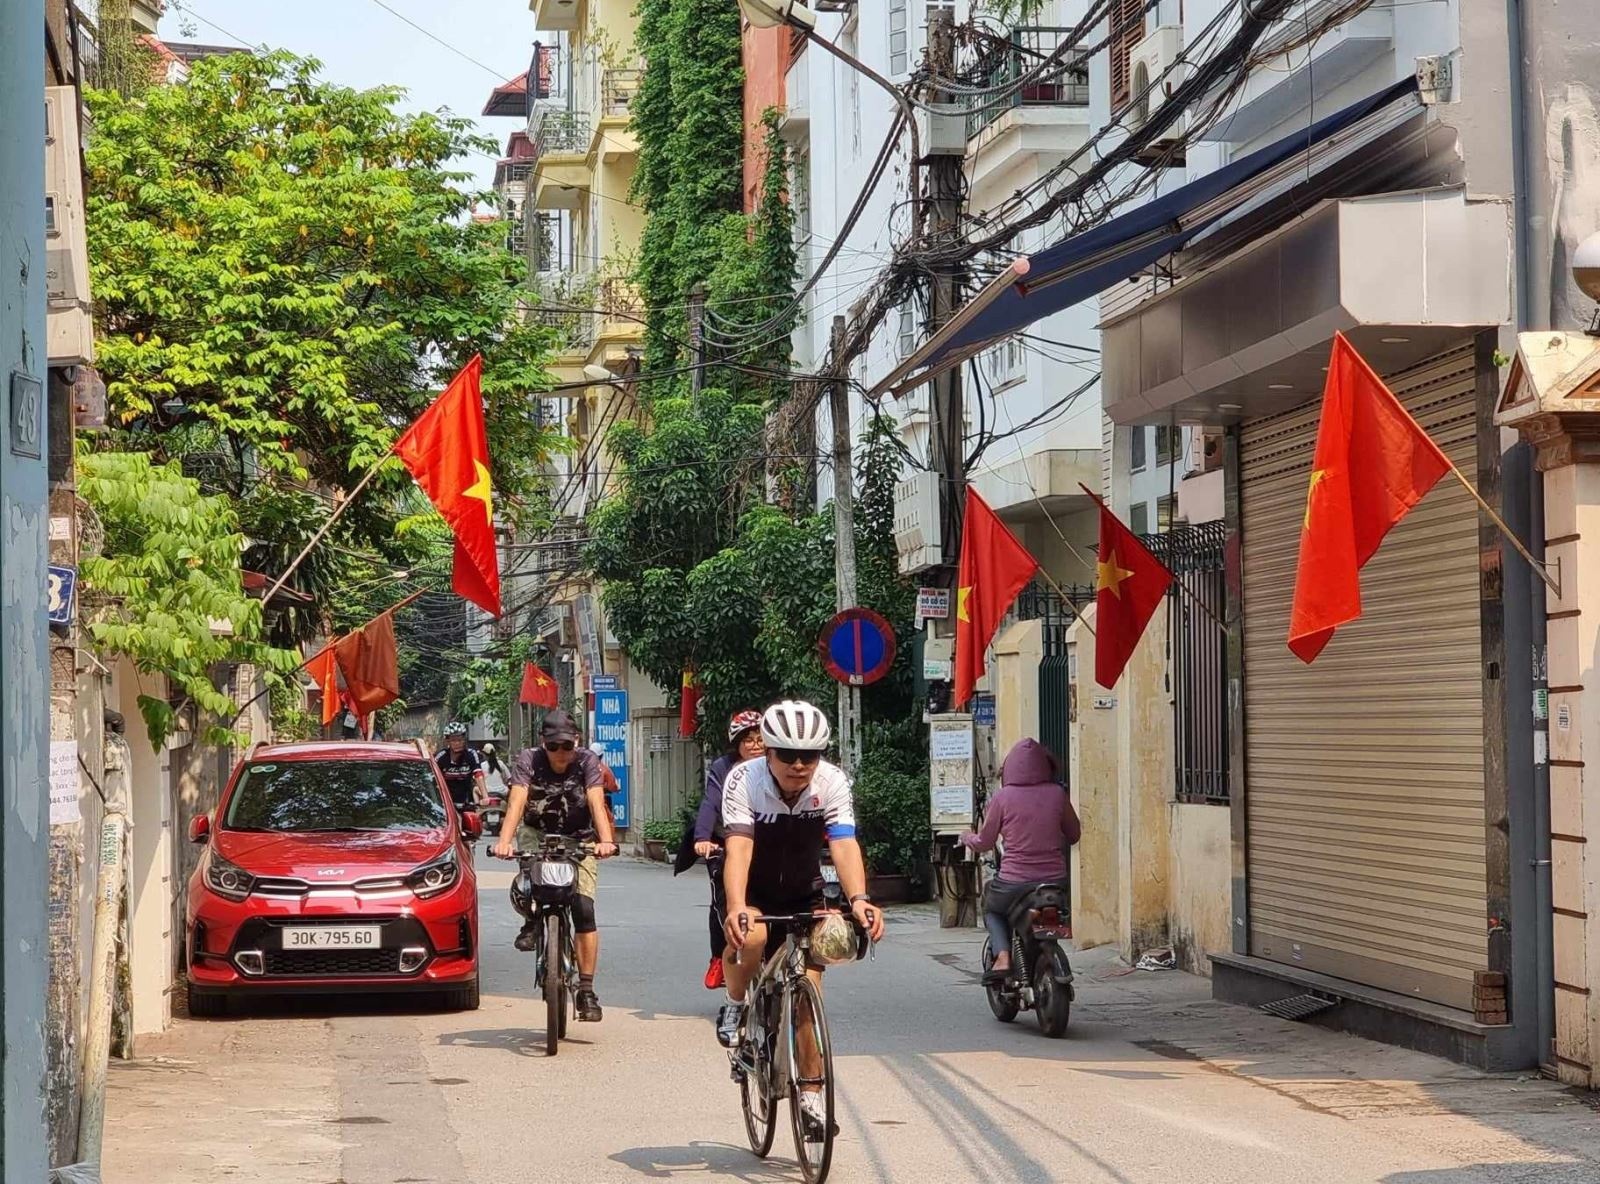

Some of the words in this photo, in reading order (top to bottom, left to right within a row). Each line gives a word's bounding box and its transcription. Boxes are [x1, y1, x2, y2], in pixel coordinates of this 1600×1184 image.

[18, 387, 37, 444] 48
[602, 695, 620, 714] NHÀ
[598, 720, 625, 741] THUỐC
[317, 869, 345, 877] KIA
